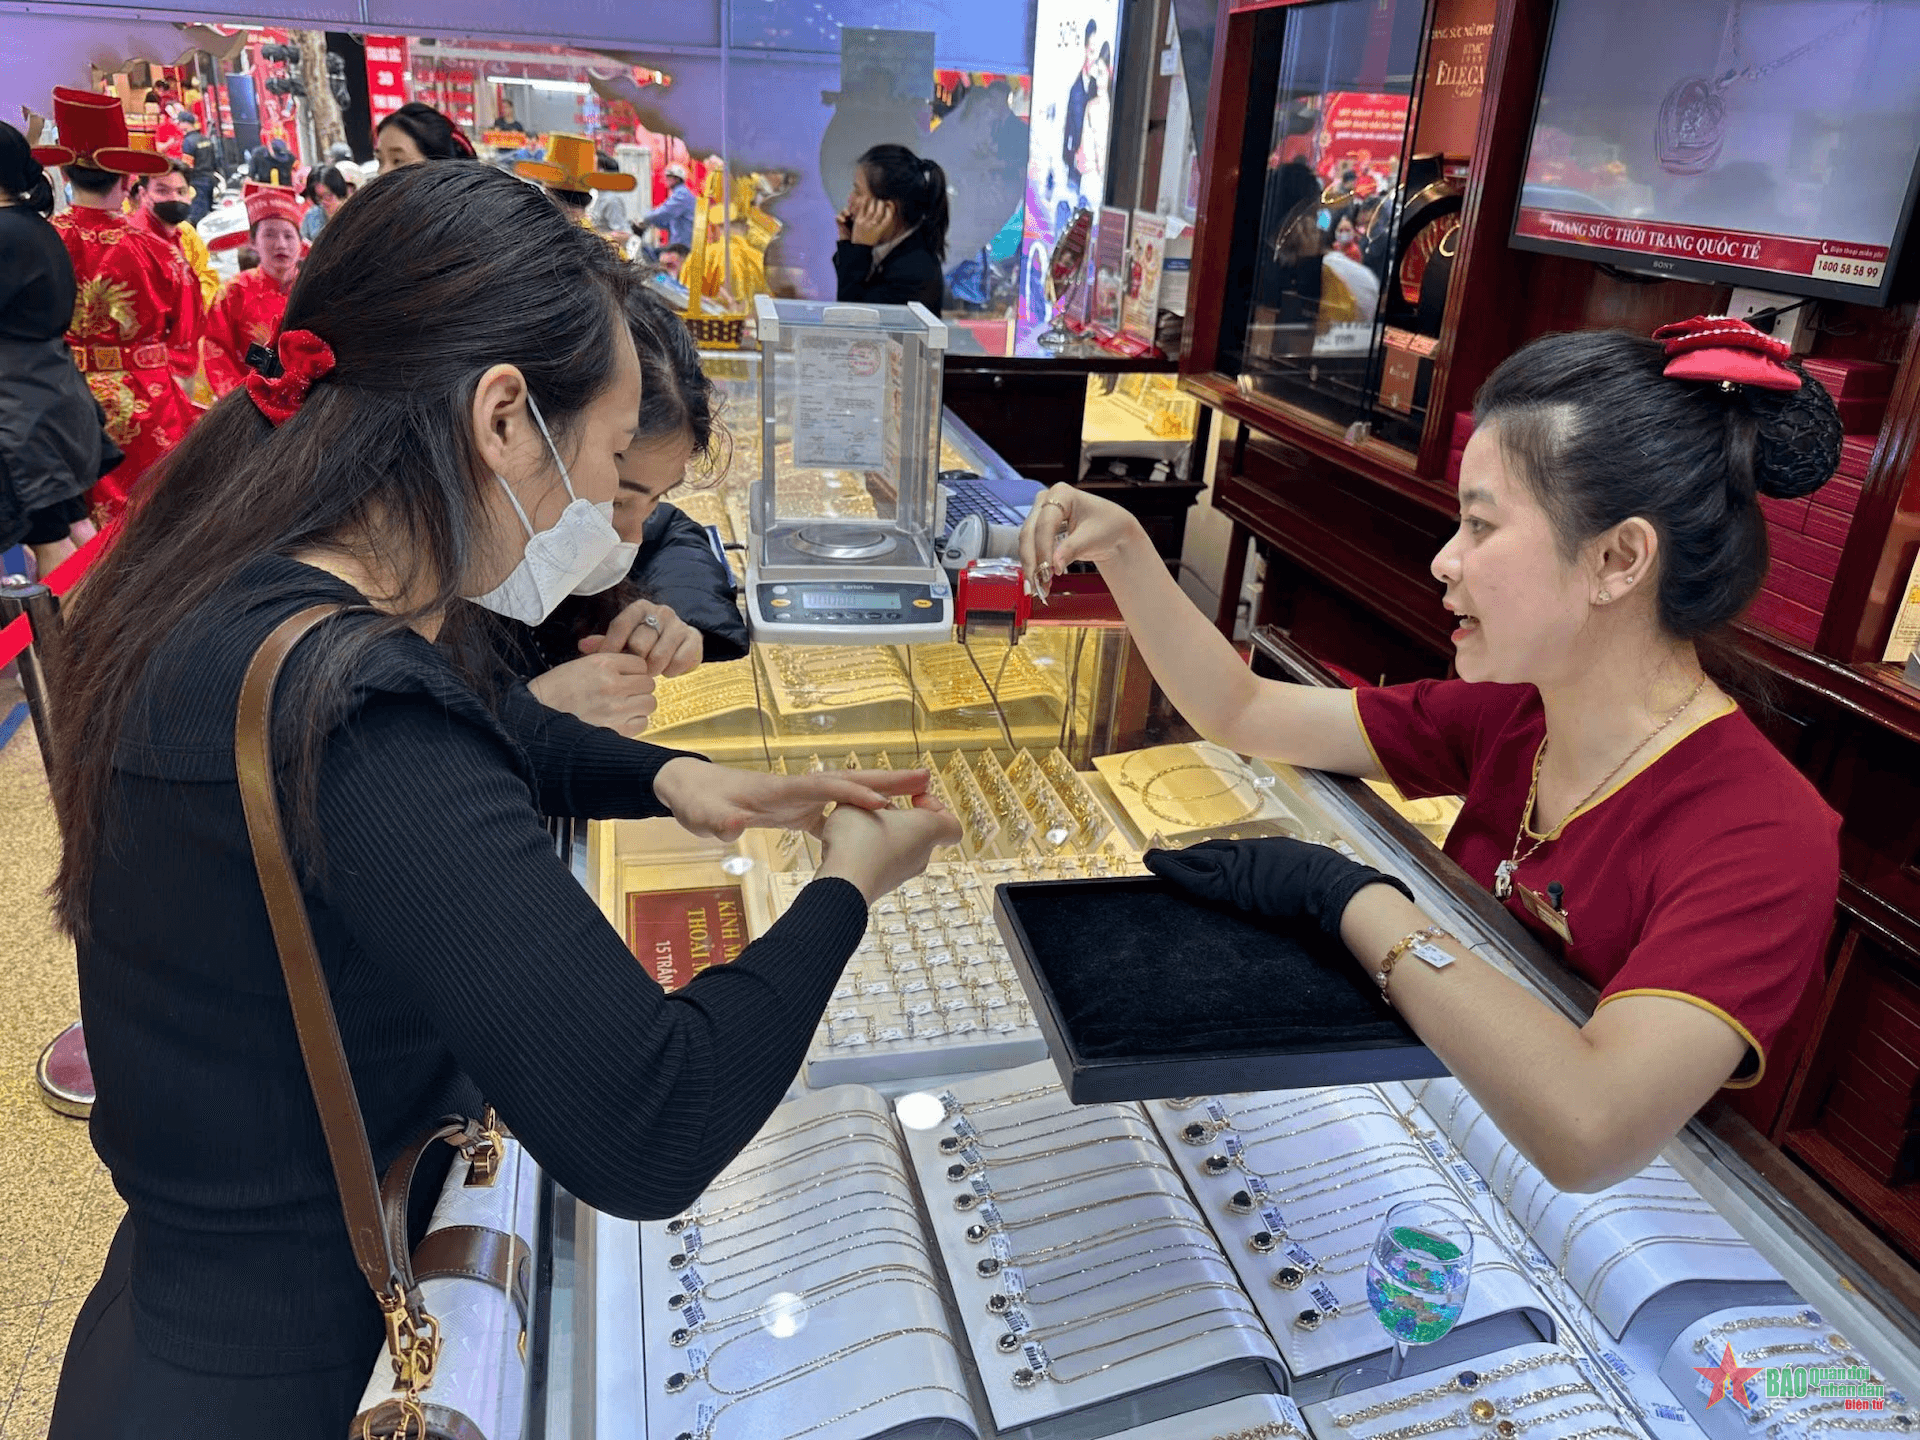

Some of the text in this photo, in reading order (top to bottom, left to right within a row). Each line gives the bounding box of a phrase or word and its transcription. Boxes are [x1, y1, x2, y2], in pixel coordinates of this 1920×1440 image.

[1435, 60, 1485, 86] ELLEGA
[1550, 220, 1762, 260] TRANG SỨC THỜI TRANG QUỐC TẾ
[1653, 260, 1675, 270] SONY
[1818, 260, 1879, 278] 1800 58 58 99
[718, 901, 742, 939] KÍNH
[655, 940, 672, 954] 15
